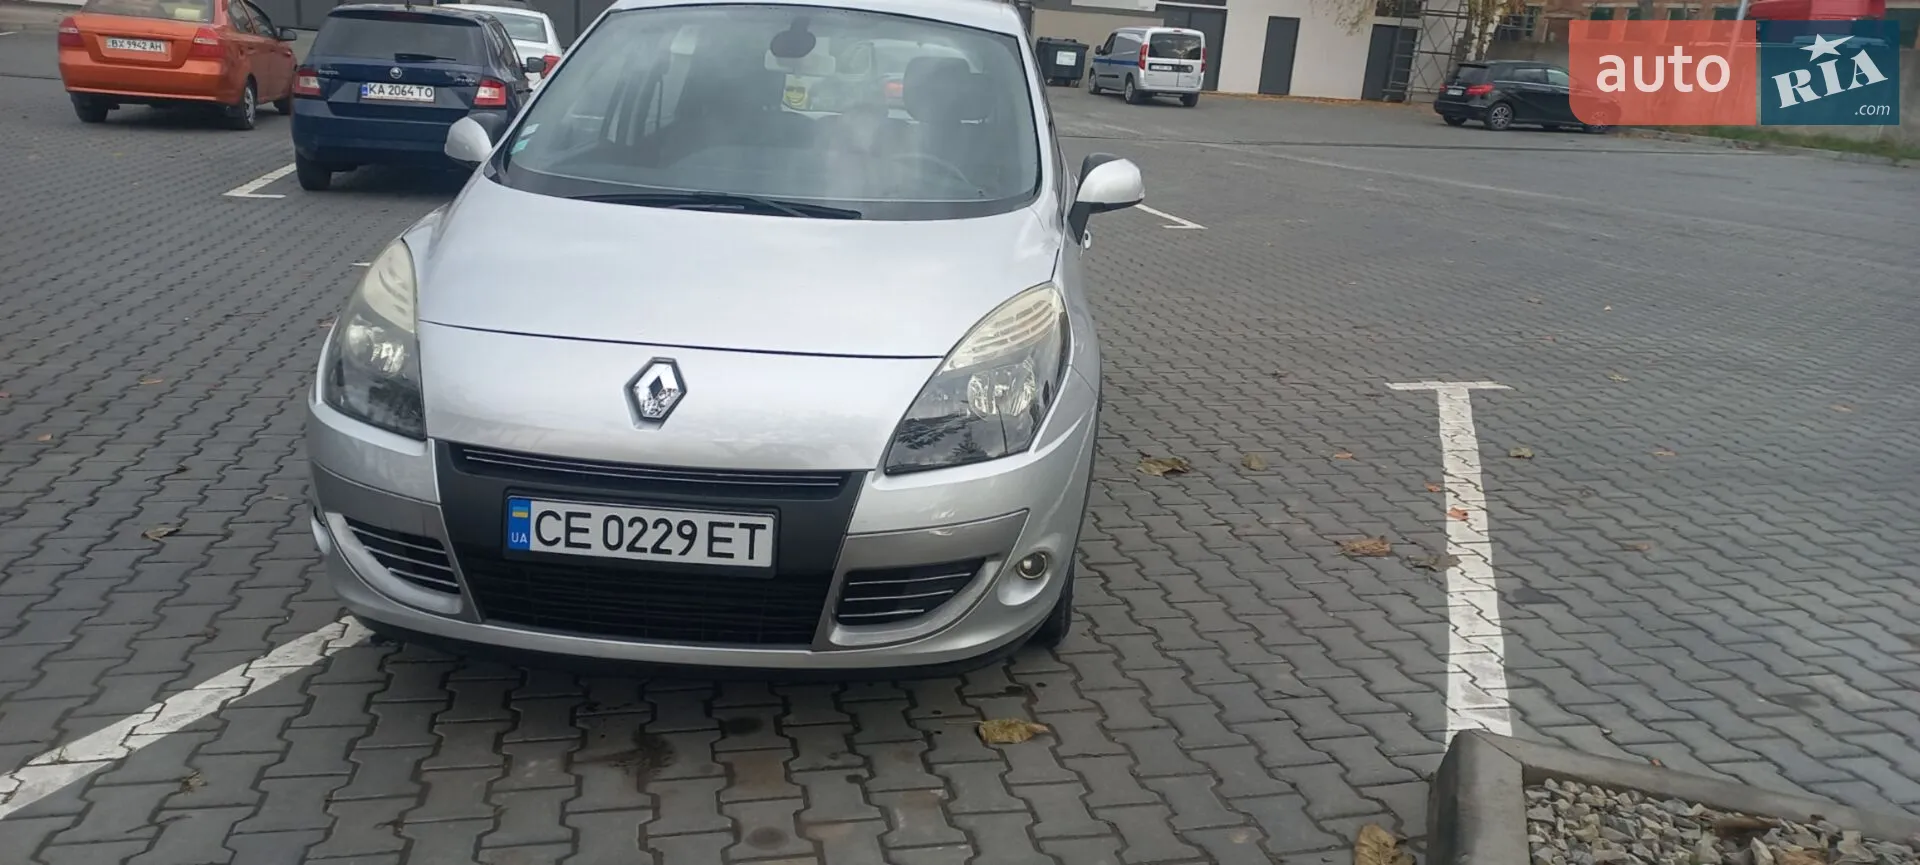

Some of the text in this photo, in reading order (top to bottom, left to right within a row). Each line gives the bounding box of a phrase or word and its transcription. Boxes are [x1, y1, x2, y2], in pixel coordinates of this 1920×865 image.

[368, 83, 433, 98] KA 2064 TO
[511, 532, 528, 544] UA
[534, 510, 767, 560] CE 0229 ET
